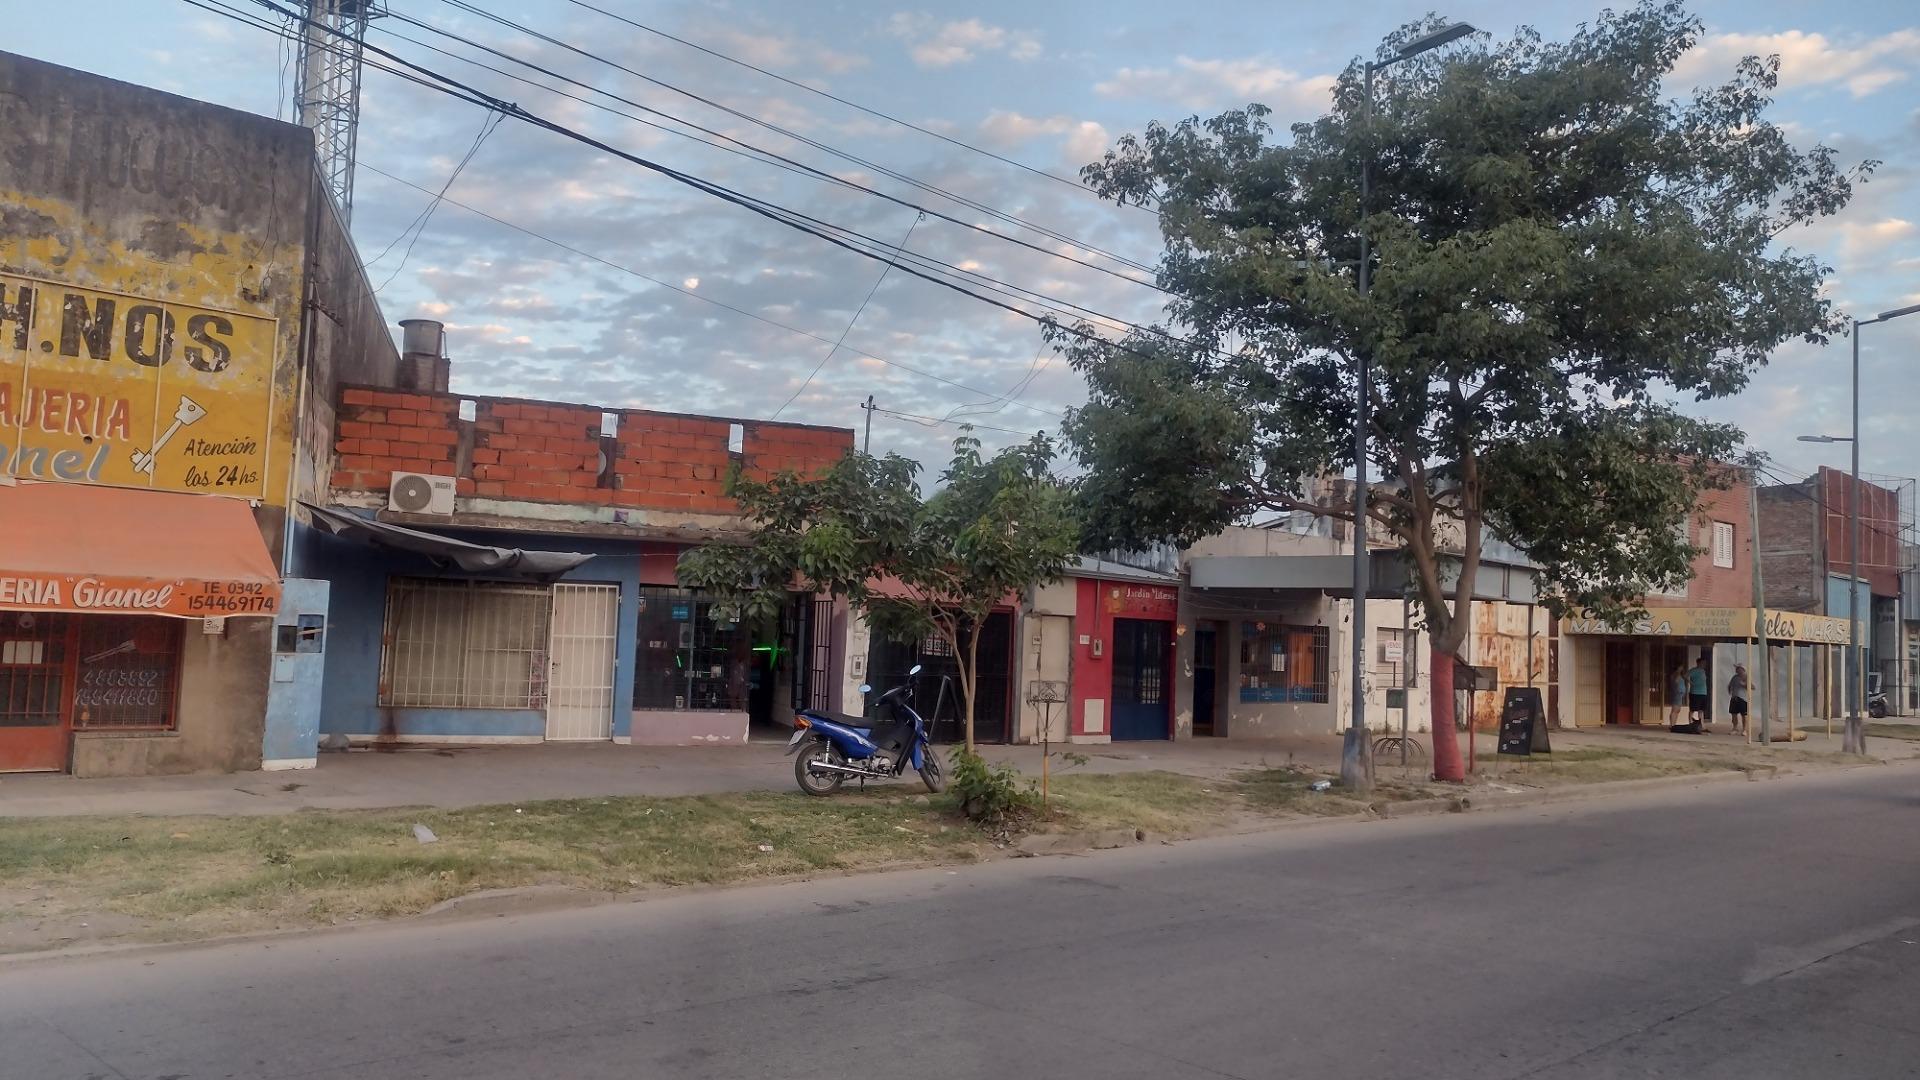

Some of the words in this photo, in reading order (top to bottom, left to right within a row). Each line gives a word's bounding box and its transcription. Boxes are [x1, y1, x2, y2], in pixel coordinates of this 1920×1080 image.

[183, 436, 257, 457] Atención
[216, 465, 239, 487] 24
[227, 582, 263, 595] 0342
[188, 596, 274, 611] 154469174
